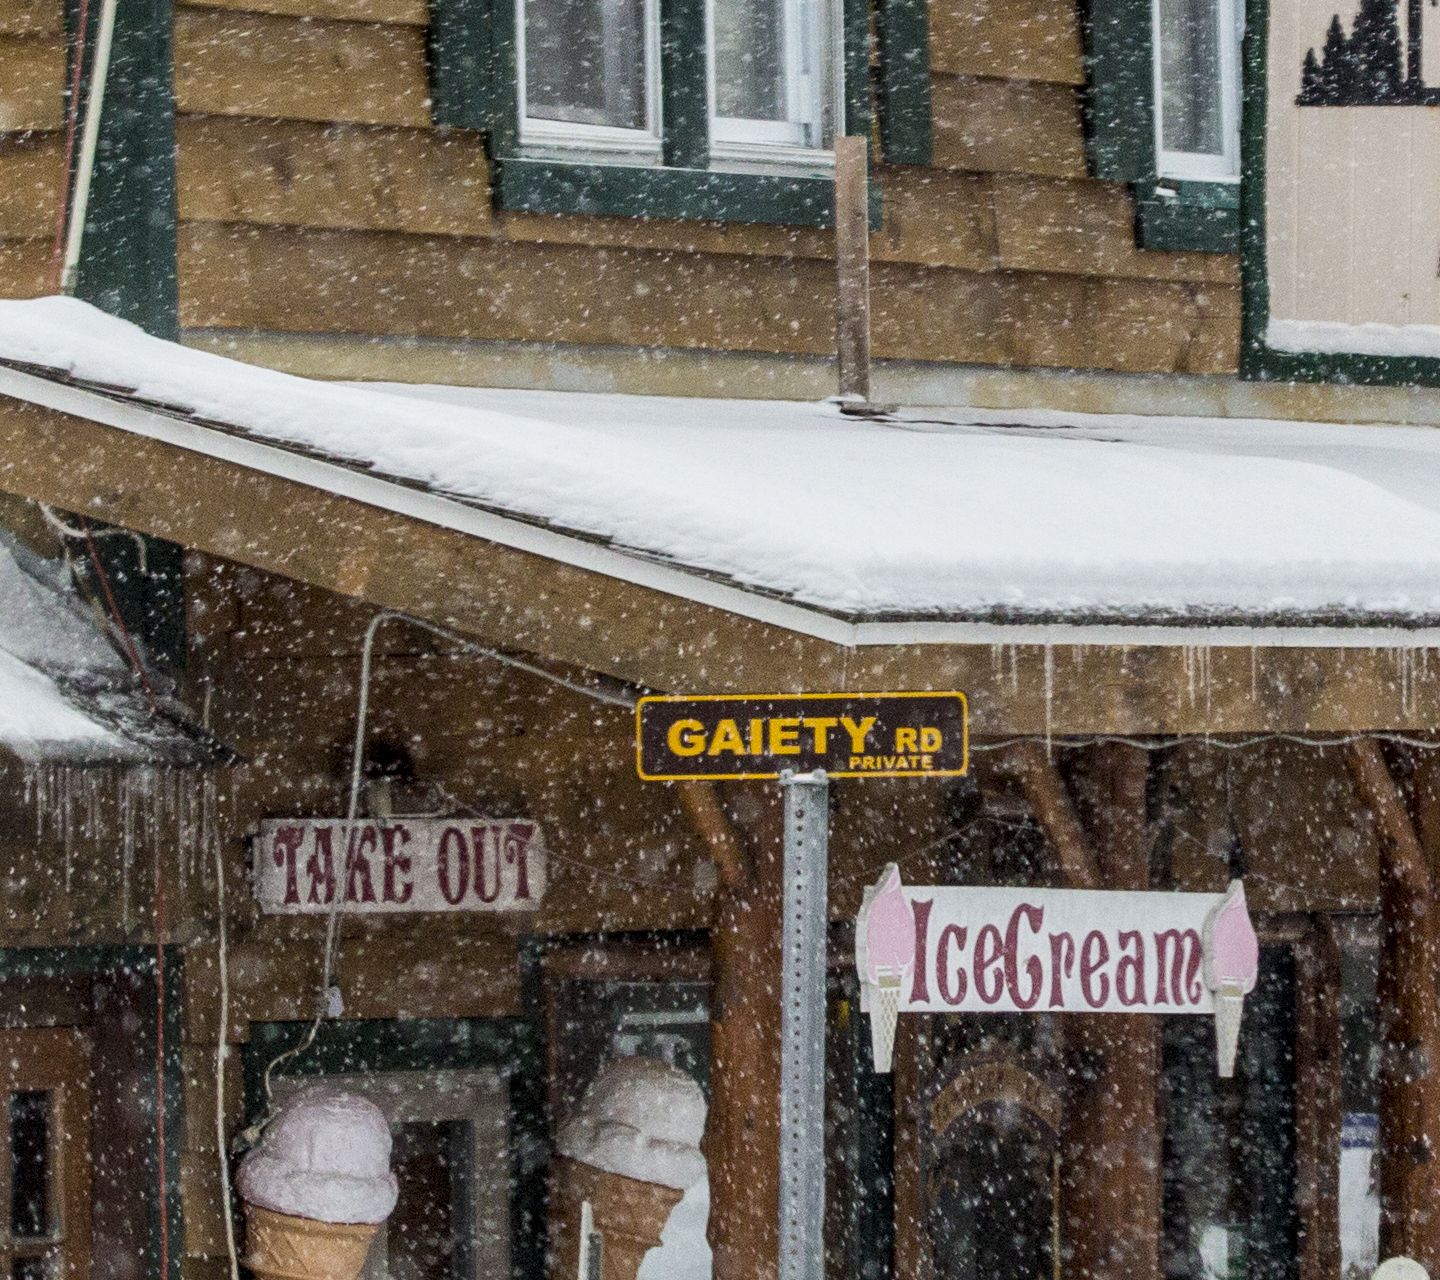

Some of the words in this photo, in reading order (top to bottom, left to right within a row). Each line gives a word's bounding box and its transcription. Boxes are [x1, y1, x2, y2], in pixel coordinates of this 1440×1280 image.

[667, 716, 877, 757] GAIETY
[895, 726, 943, 753] RD
[848, 754, 934, 770] PRIVATE
[272, 823, 414, 904] TAKE
[436, 823, 535, 906] OUT
